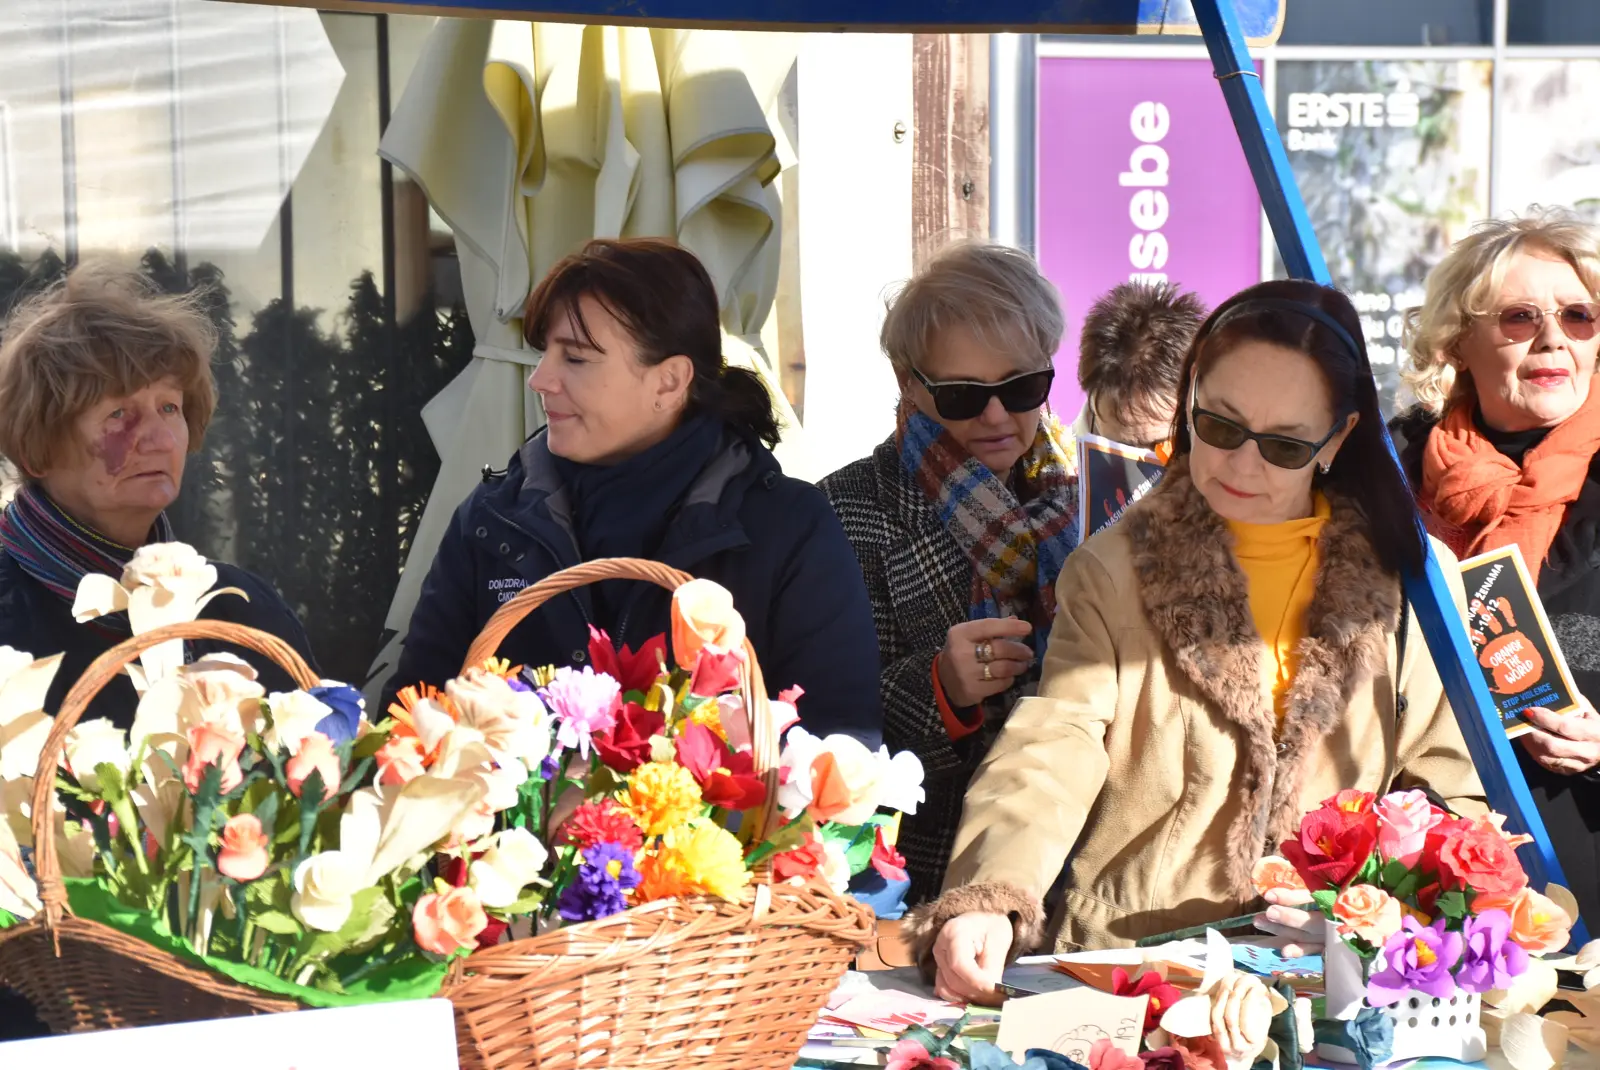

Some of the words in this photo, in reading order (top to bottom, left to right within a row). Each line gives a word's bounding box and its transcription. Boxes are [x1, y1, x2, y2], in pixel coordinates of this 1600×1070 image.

[1288, 92, 1384, 127] ERSTE
[1288, 128, 1337, 151] Bank
[1474, 562, 1504, 601] ŽENAMA
[1489, 639, 1524, 667] ORANGE
[1503, 654, 1522, 670] THE
[1504, 659, 1534, 684] WORLD
[1501, 696, 1520, 709] STOP
[1519, 682, 1552, 701] VIOLENCE
[1533, 692, 1560, 707] WOMEN
